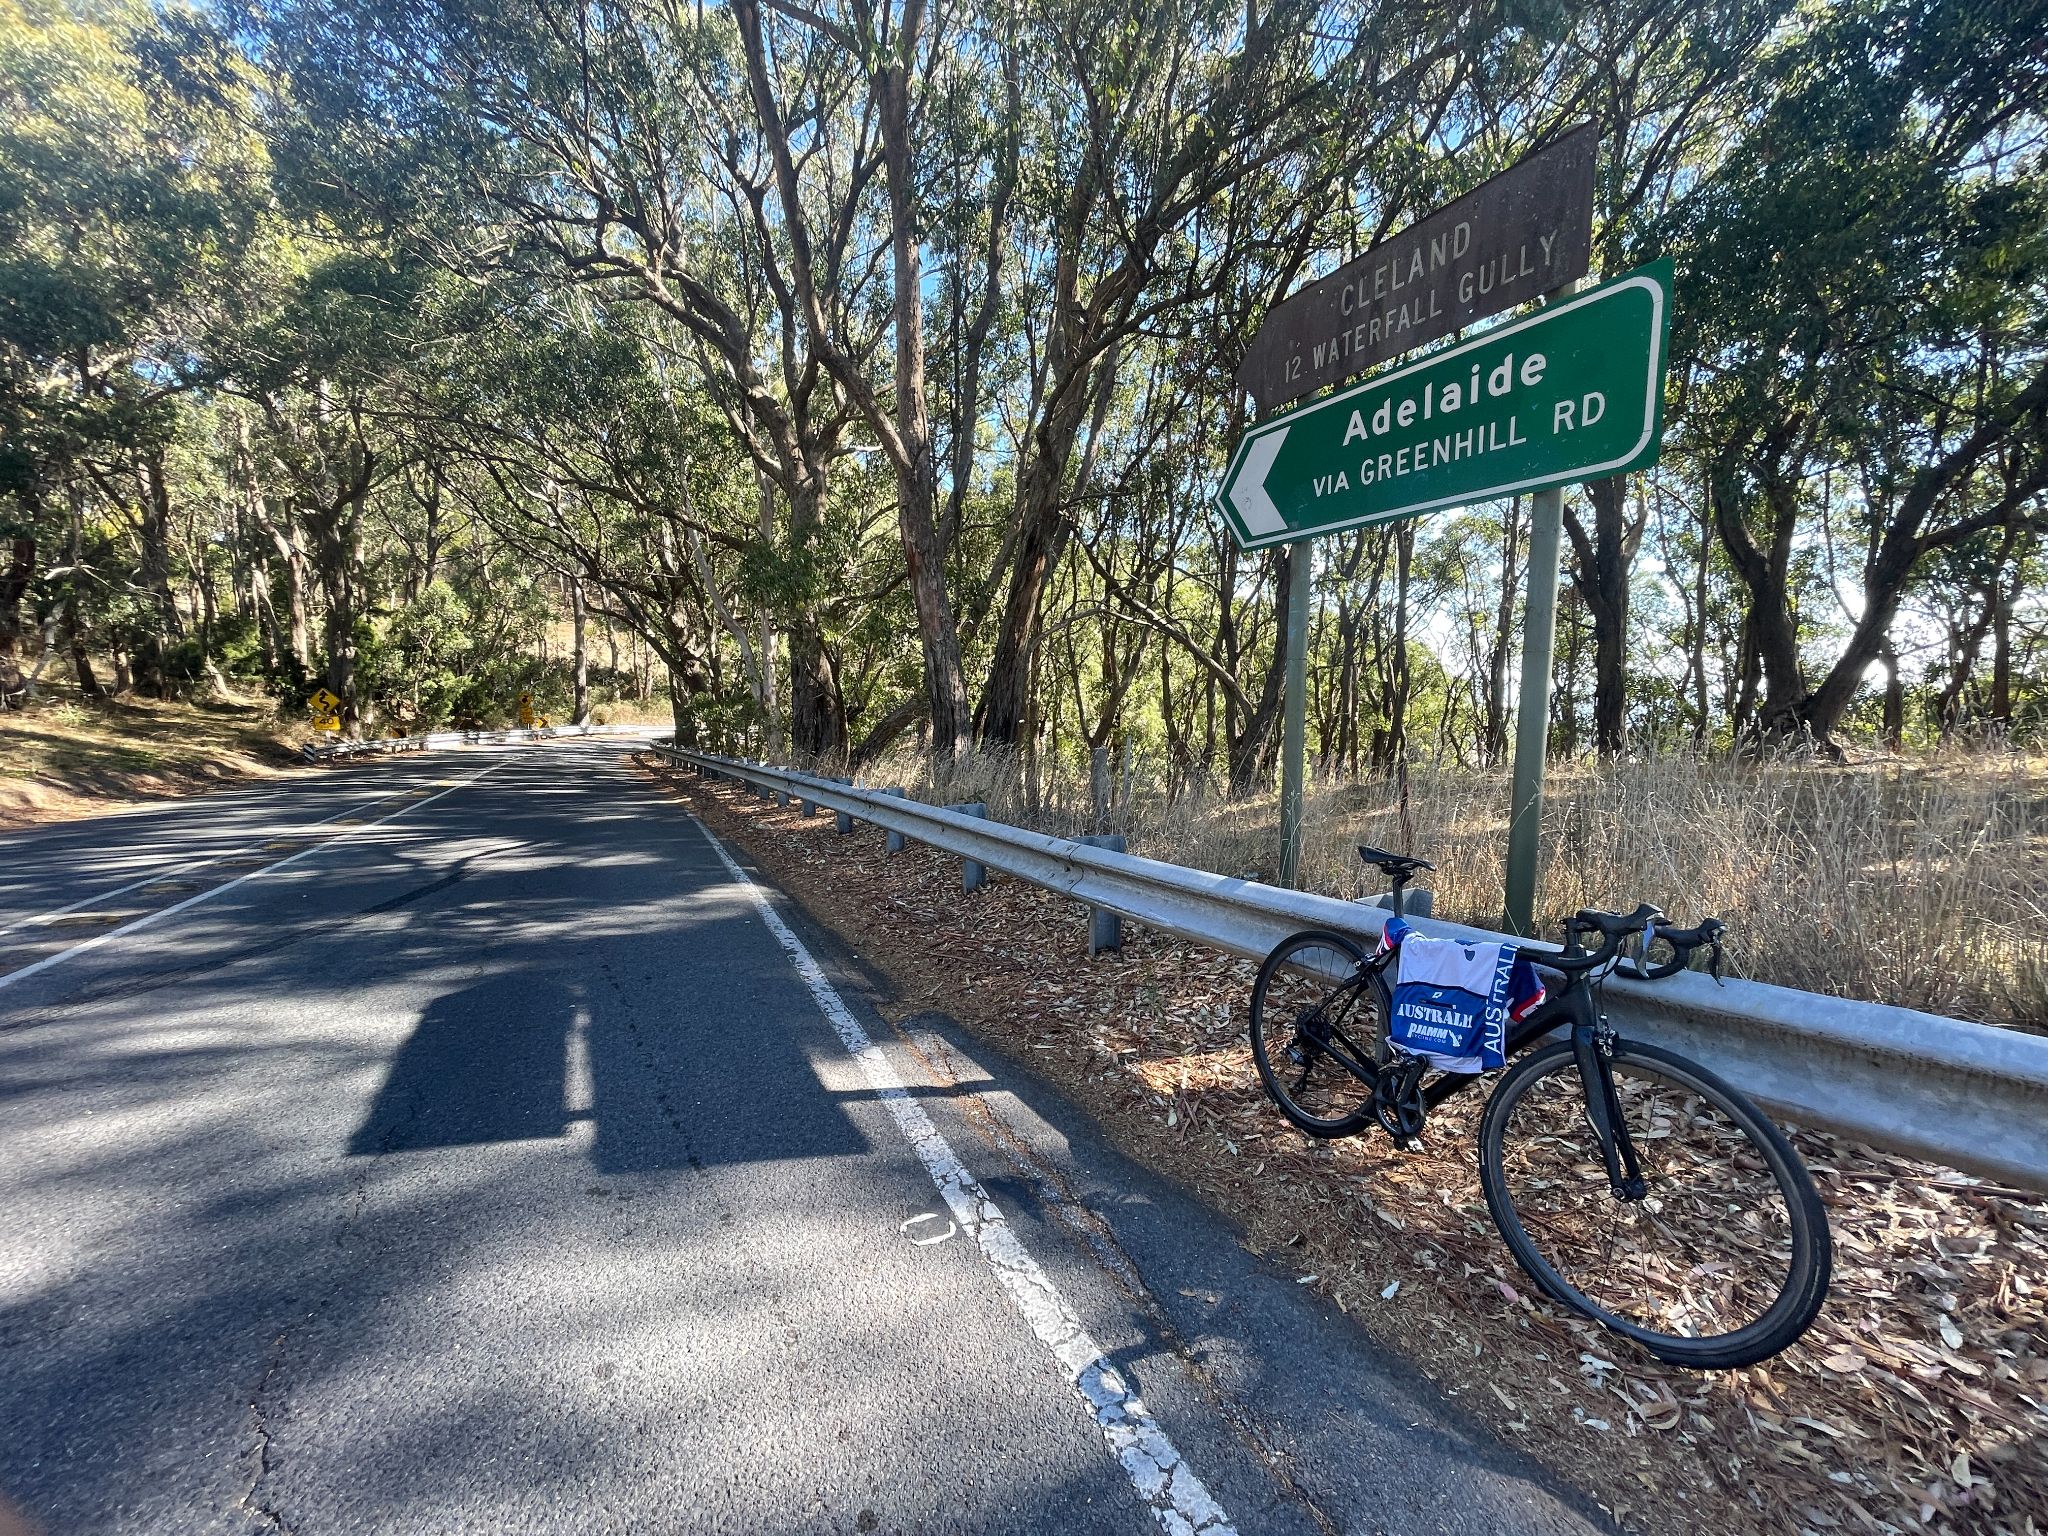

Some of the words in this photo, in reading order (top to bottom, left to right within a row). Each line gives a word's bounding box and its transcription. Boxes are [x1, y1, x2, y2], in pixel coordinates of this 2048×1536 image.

[1285, 355, 1301, 384] 12
[1312, 289, 1443, 370] WATERFALL
[1458, 229, 1558, 304] GULLY
[1340, 221, 1471, 317] CLELAND
[1312, 470, 1350, 498] VIA
[1360, 415, 1527, 485] GREENHILL
[1552, 391, 1606, 435] RD
[1342, 353, 1547, 447] Adelaide
[319, 717, 334, 725] 40
